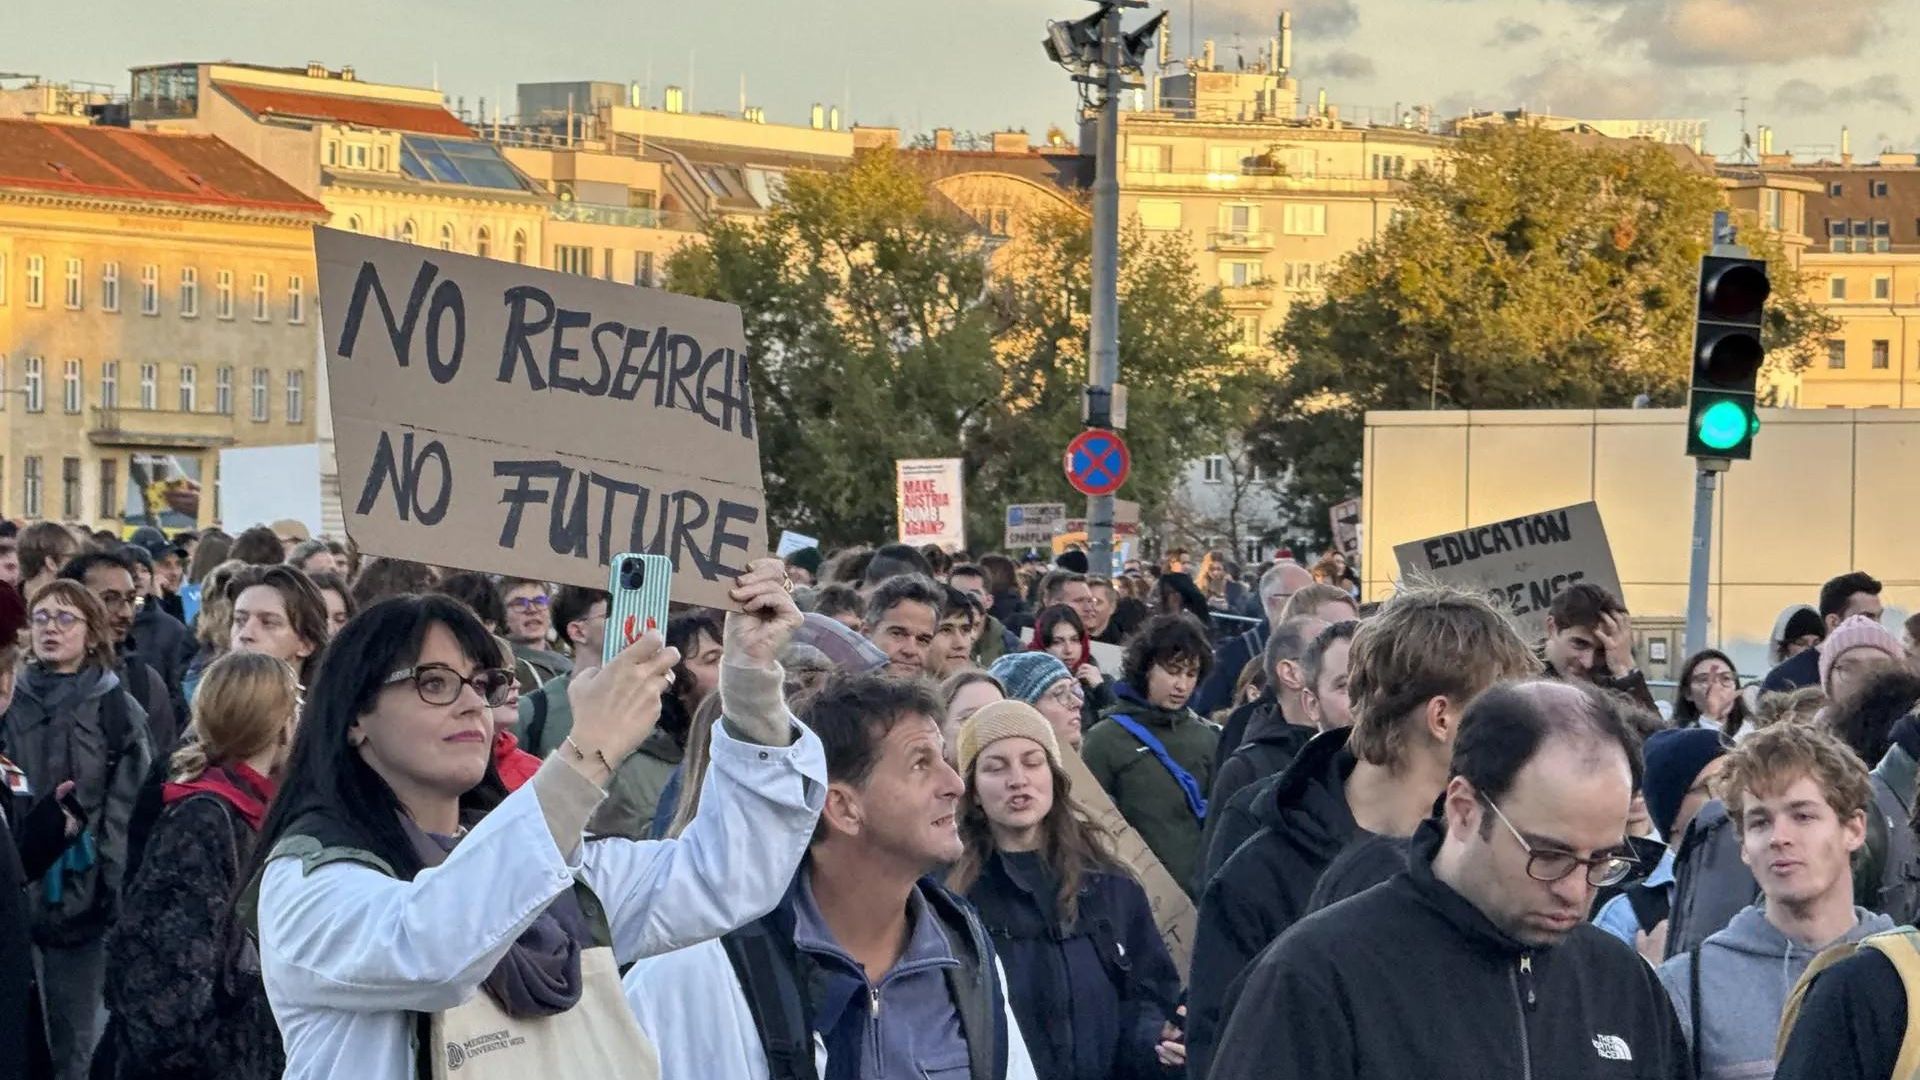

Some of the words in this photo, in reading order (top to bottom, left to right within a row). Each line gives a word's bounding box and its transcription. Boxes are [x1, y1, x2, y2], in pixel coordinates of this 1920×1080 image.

[337, 259, 466, 384] NO
[496, 285, 756, 440] RESEARCH
[355, 430, 452, 526] NO
[493, 460, 759, 581] FUTURE
[903, 480, 936, 493] MAKE
[904, 493, 949, 508] AUSTRIA
[1423, 511, 1571, 570] EDUCATION
